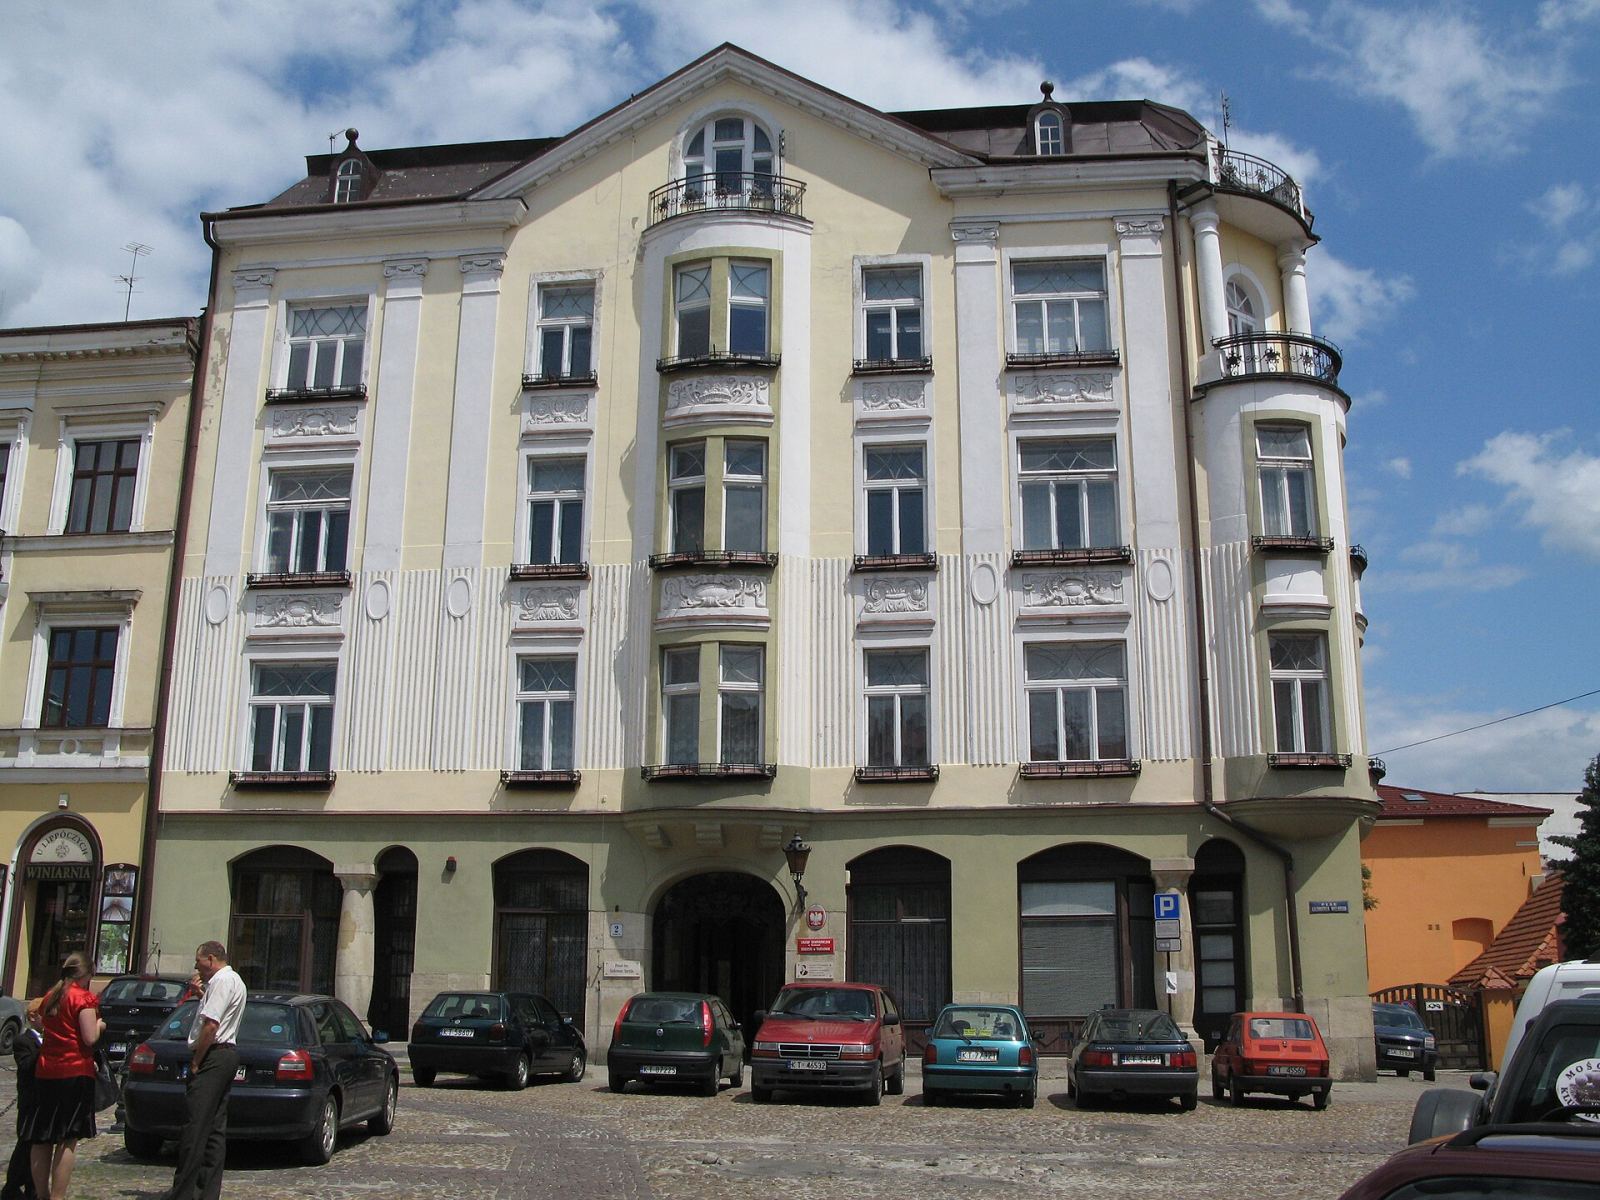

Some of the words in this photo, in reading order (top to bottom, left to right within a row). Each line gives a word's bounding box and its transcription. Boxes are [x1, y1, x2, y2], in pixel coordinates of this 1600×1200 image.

[36, 848, 44, 856] U
[41, 830, 89, 856] LIPPÓCZYCH
[27, 866, 91, 879] WINIARNIA
[1160, 897, 1174, 917] P
[614, 925, 619, 933] 2
